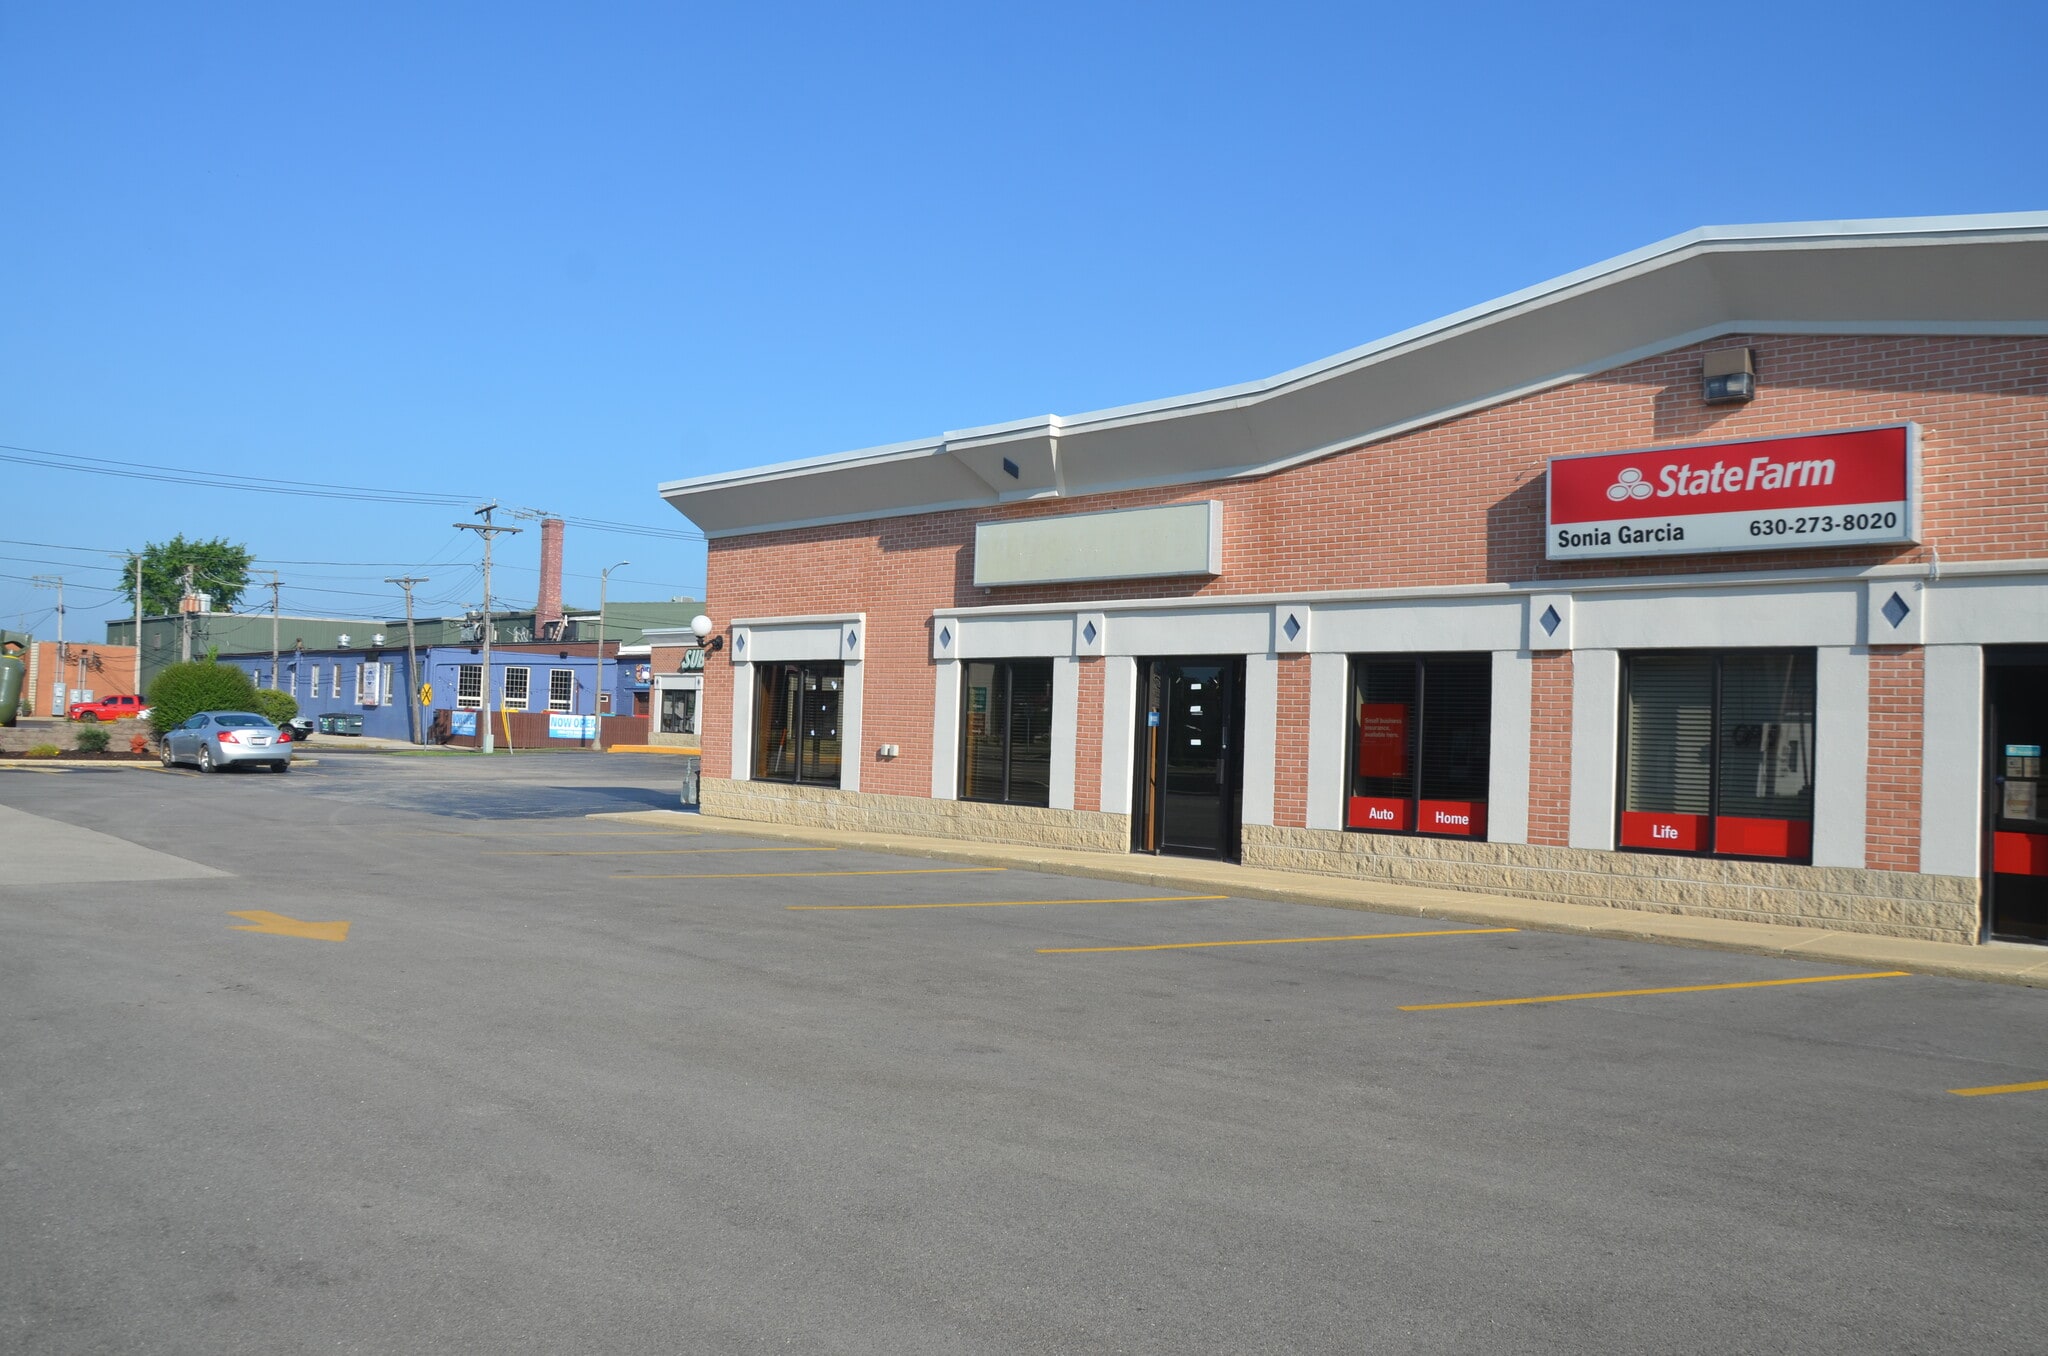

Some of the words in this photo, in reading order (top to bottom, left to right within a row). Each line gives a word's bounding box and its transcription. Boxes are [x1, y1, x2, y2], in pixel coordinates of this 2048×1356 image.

[1750, 512, 1897, 536] 630-273-8020
[1558, 528, 1611, 548] Sonia
[1618, 523, 1684, 544] Garcia
[551, 717, 572, 728] NOW
[1369, 807, 1394, 820] Auto
[1435, 811, 1469, 825] Home
[1653, 824, 1678, 839] Life
